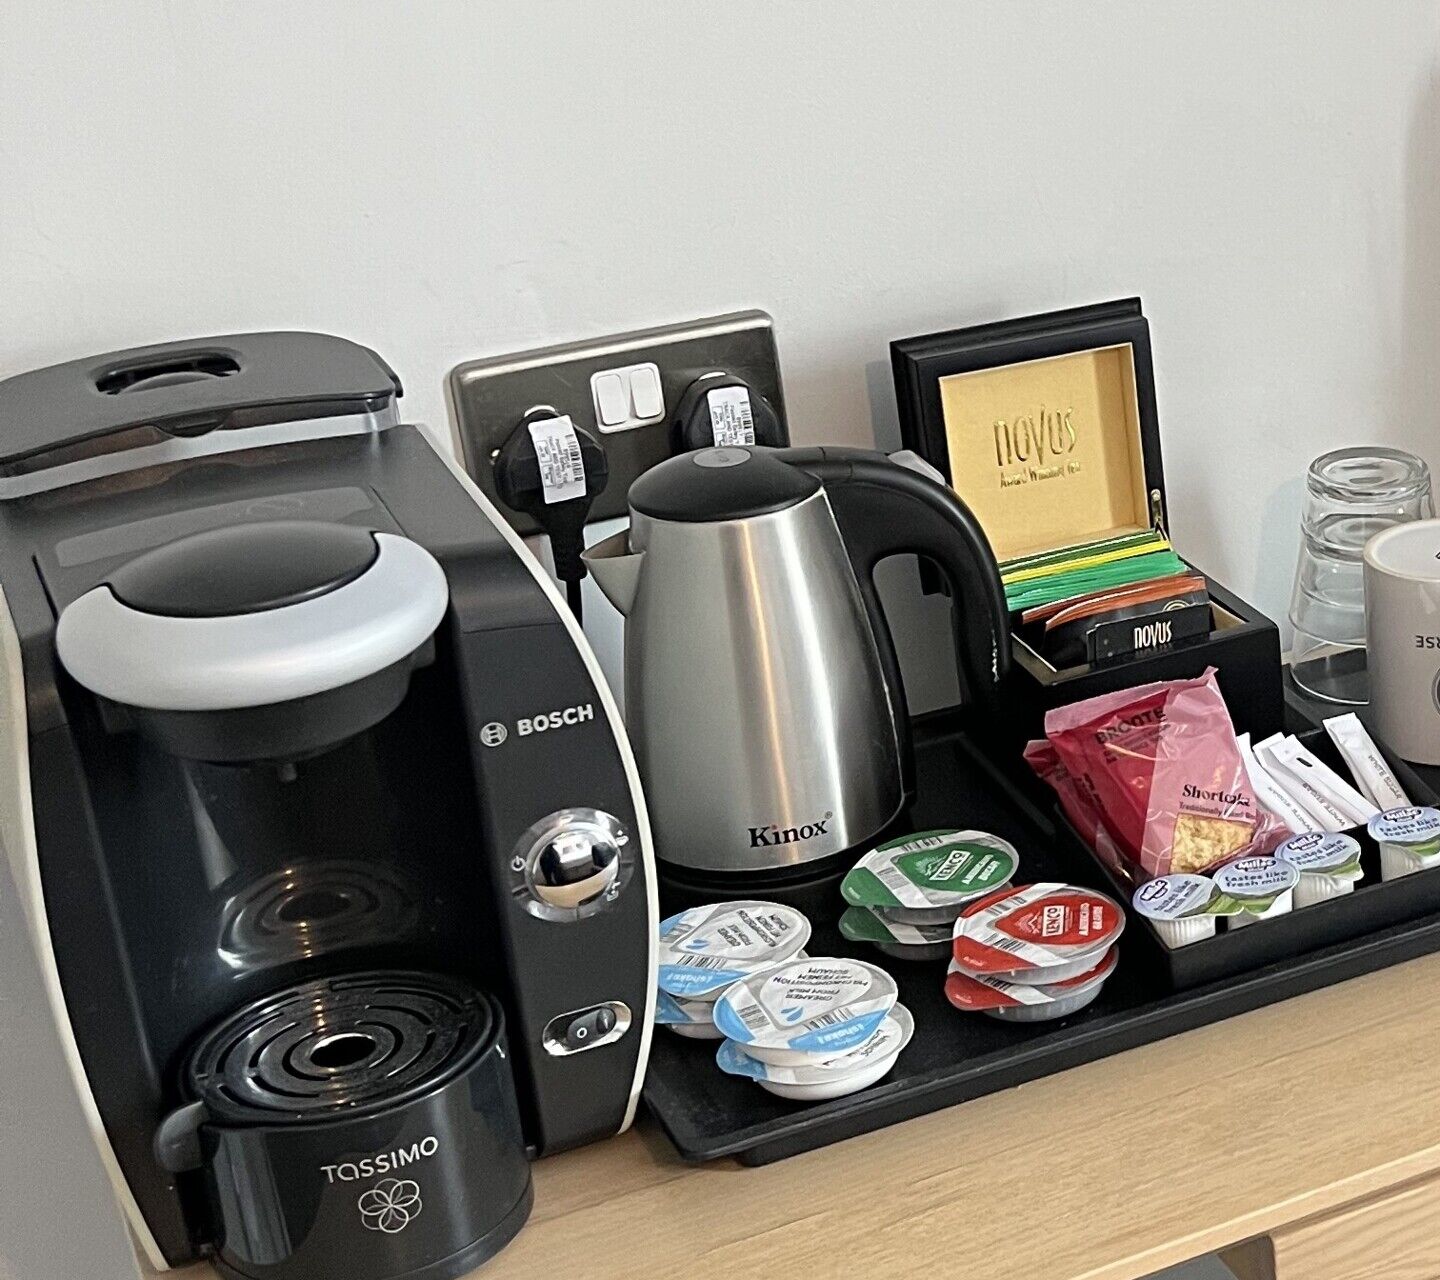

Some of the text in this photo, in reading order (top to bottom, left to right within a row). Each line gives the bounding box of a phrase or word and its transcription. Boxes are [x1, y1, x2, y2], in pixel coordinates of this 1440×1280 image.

[517, 703, 594, 737] BOSCH
[747, 820, 828, 848] Kinox
[320, 1136, 439, 1184] TASSIMO
